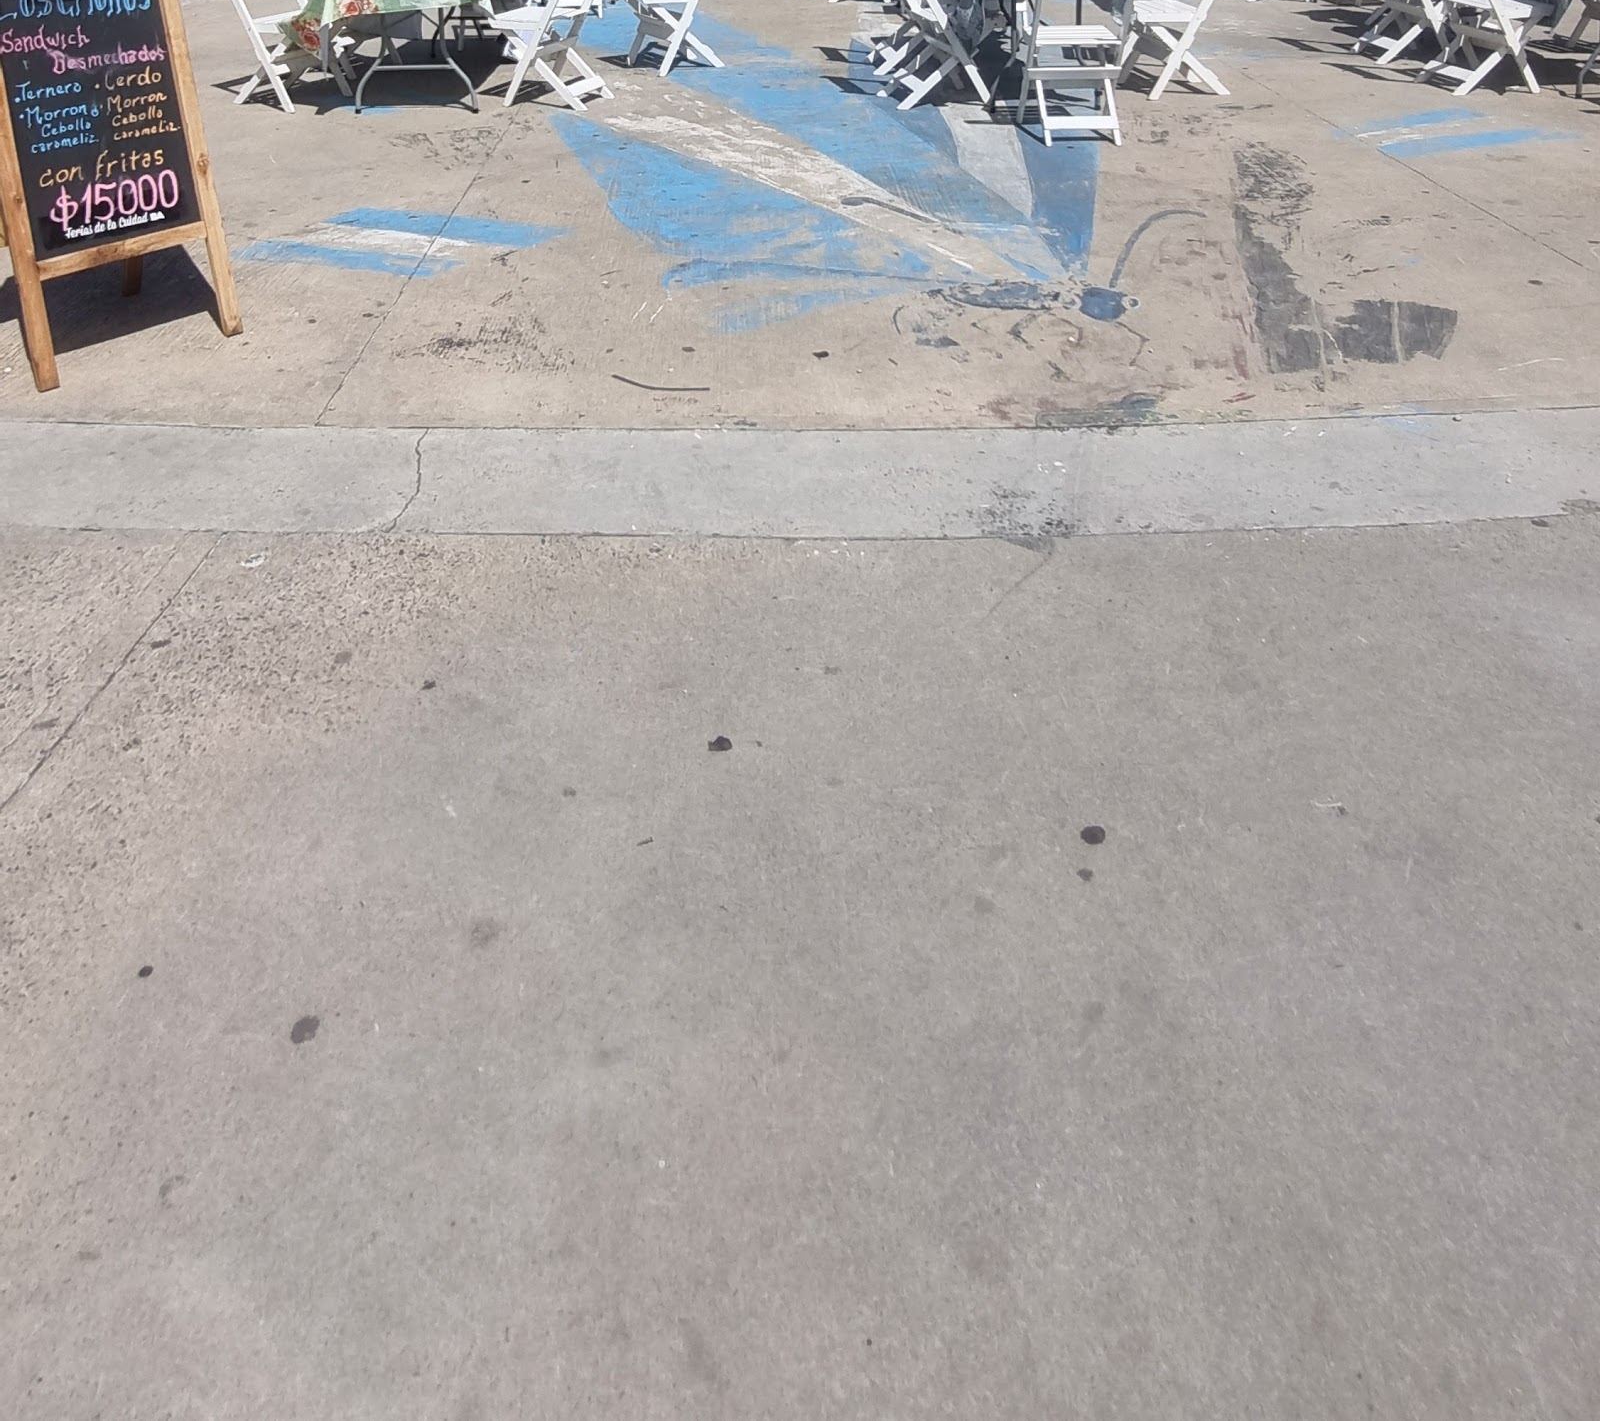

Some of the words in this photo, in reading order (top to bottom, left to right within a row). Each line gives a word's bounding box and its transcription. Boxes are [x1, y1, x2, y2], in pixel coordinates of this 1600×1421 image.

[0, 25, 91, 54] Sandwich
[105, 66, 162, 90] Cerdo
[107, 92, 168, 116] Morron
[25, 105, 88, 129] Morron
[41, 118, 92, 138] Cebolla
[40, 165, 84, 187] con
[50, 169, 179, 232] $15000
[64, 224, 94, 239] Ferias
[94, 221, 106, 234] de
[107, 219, 117, 230] la
